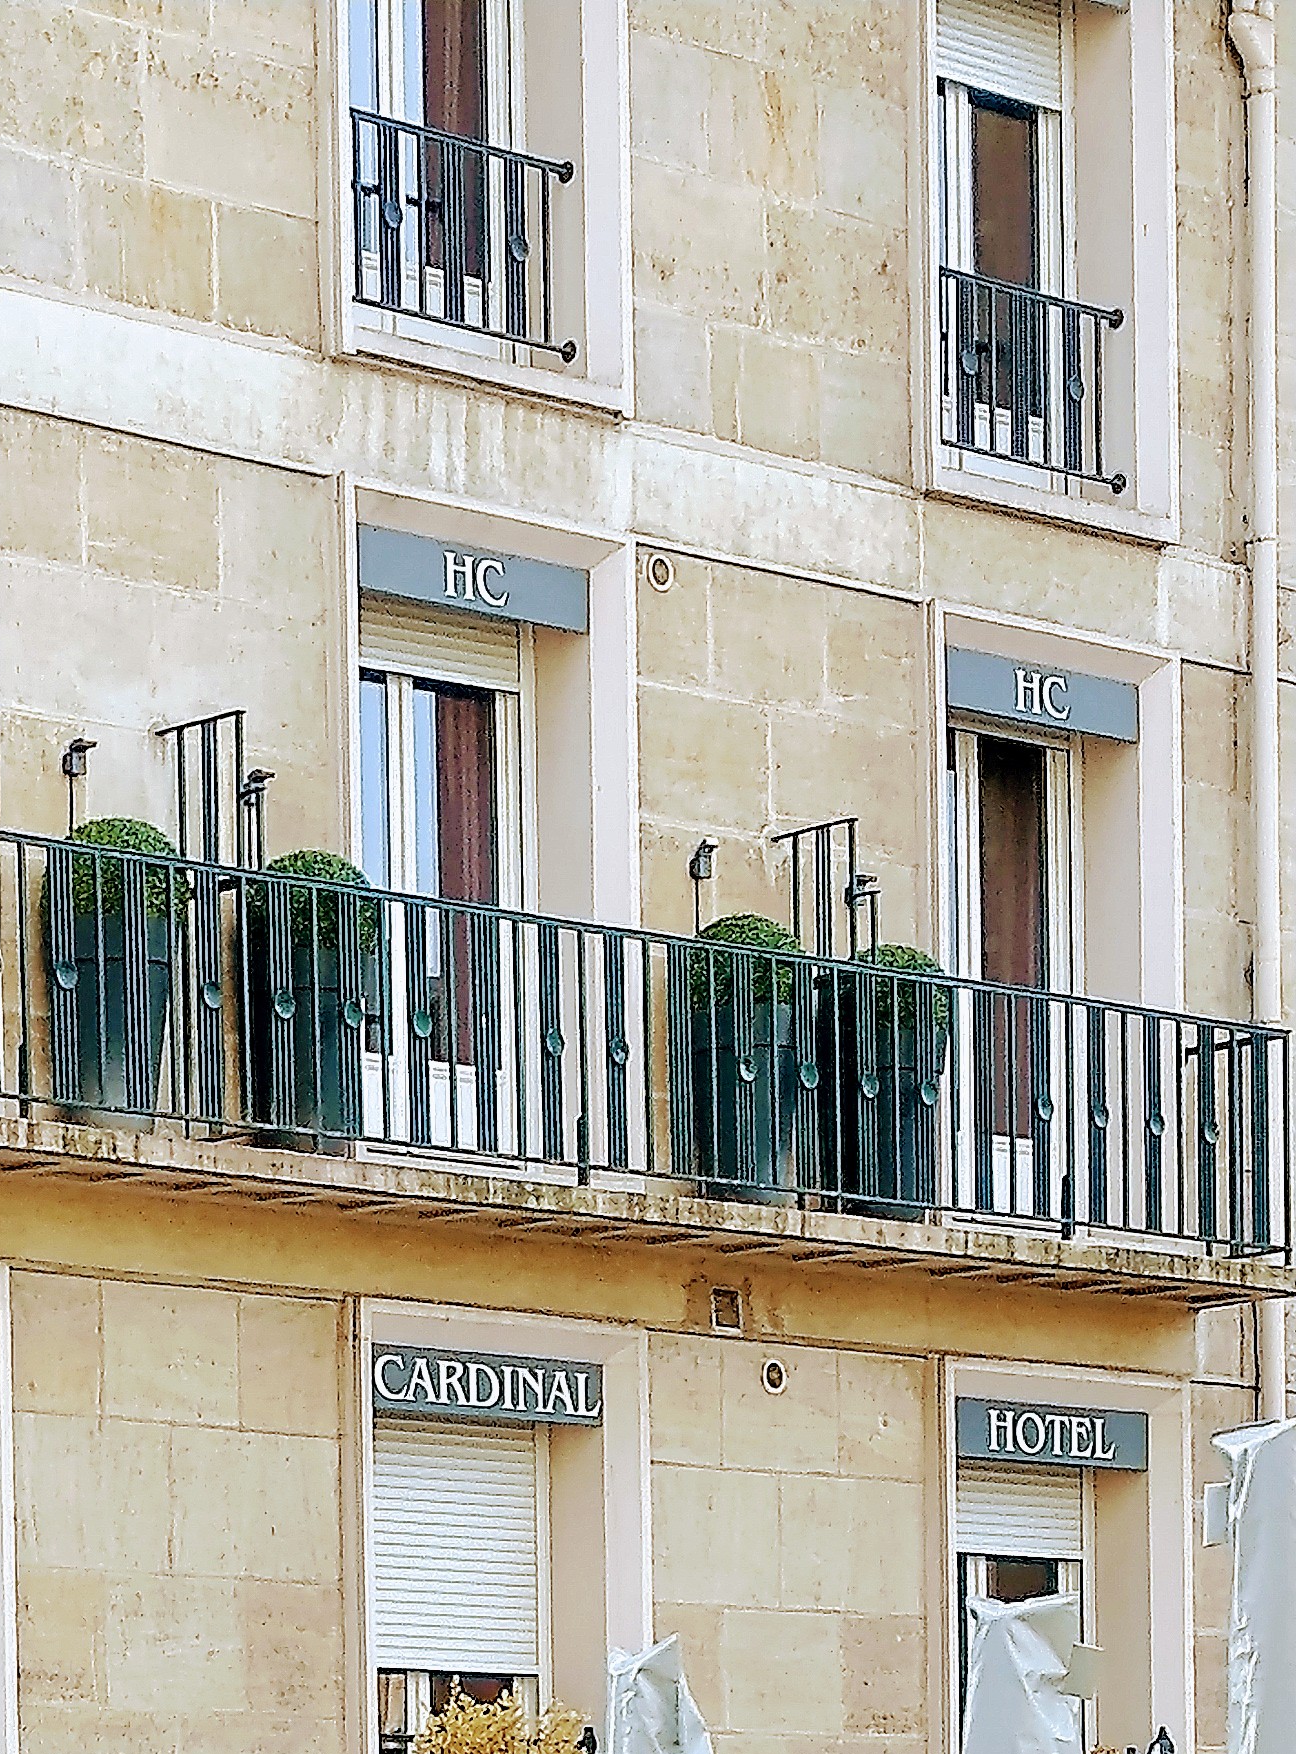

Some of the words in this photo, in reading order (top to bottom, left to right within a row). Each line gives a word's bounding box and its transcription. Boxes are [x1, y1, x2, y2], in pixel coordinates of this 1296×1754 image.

[442, 550, 509, 608] HC
[1014, 668, 1071, 720] HC
[374, 1354, 602, 1418] CARDINAL
[988, 1408, 1116, 1461] HOTEL
